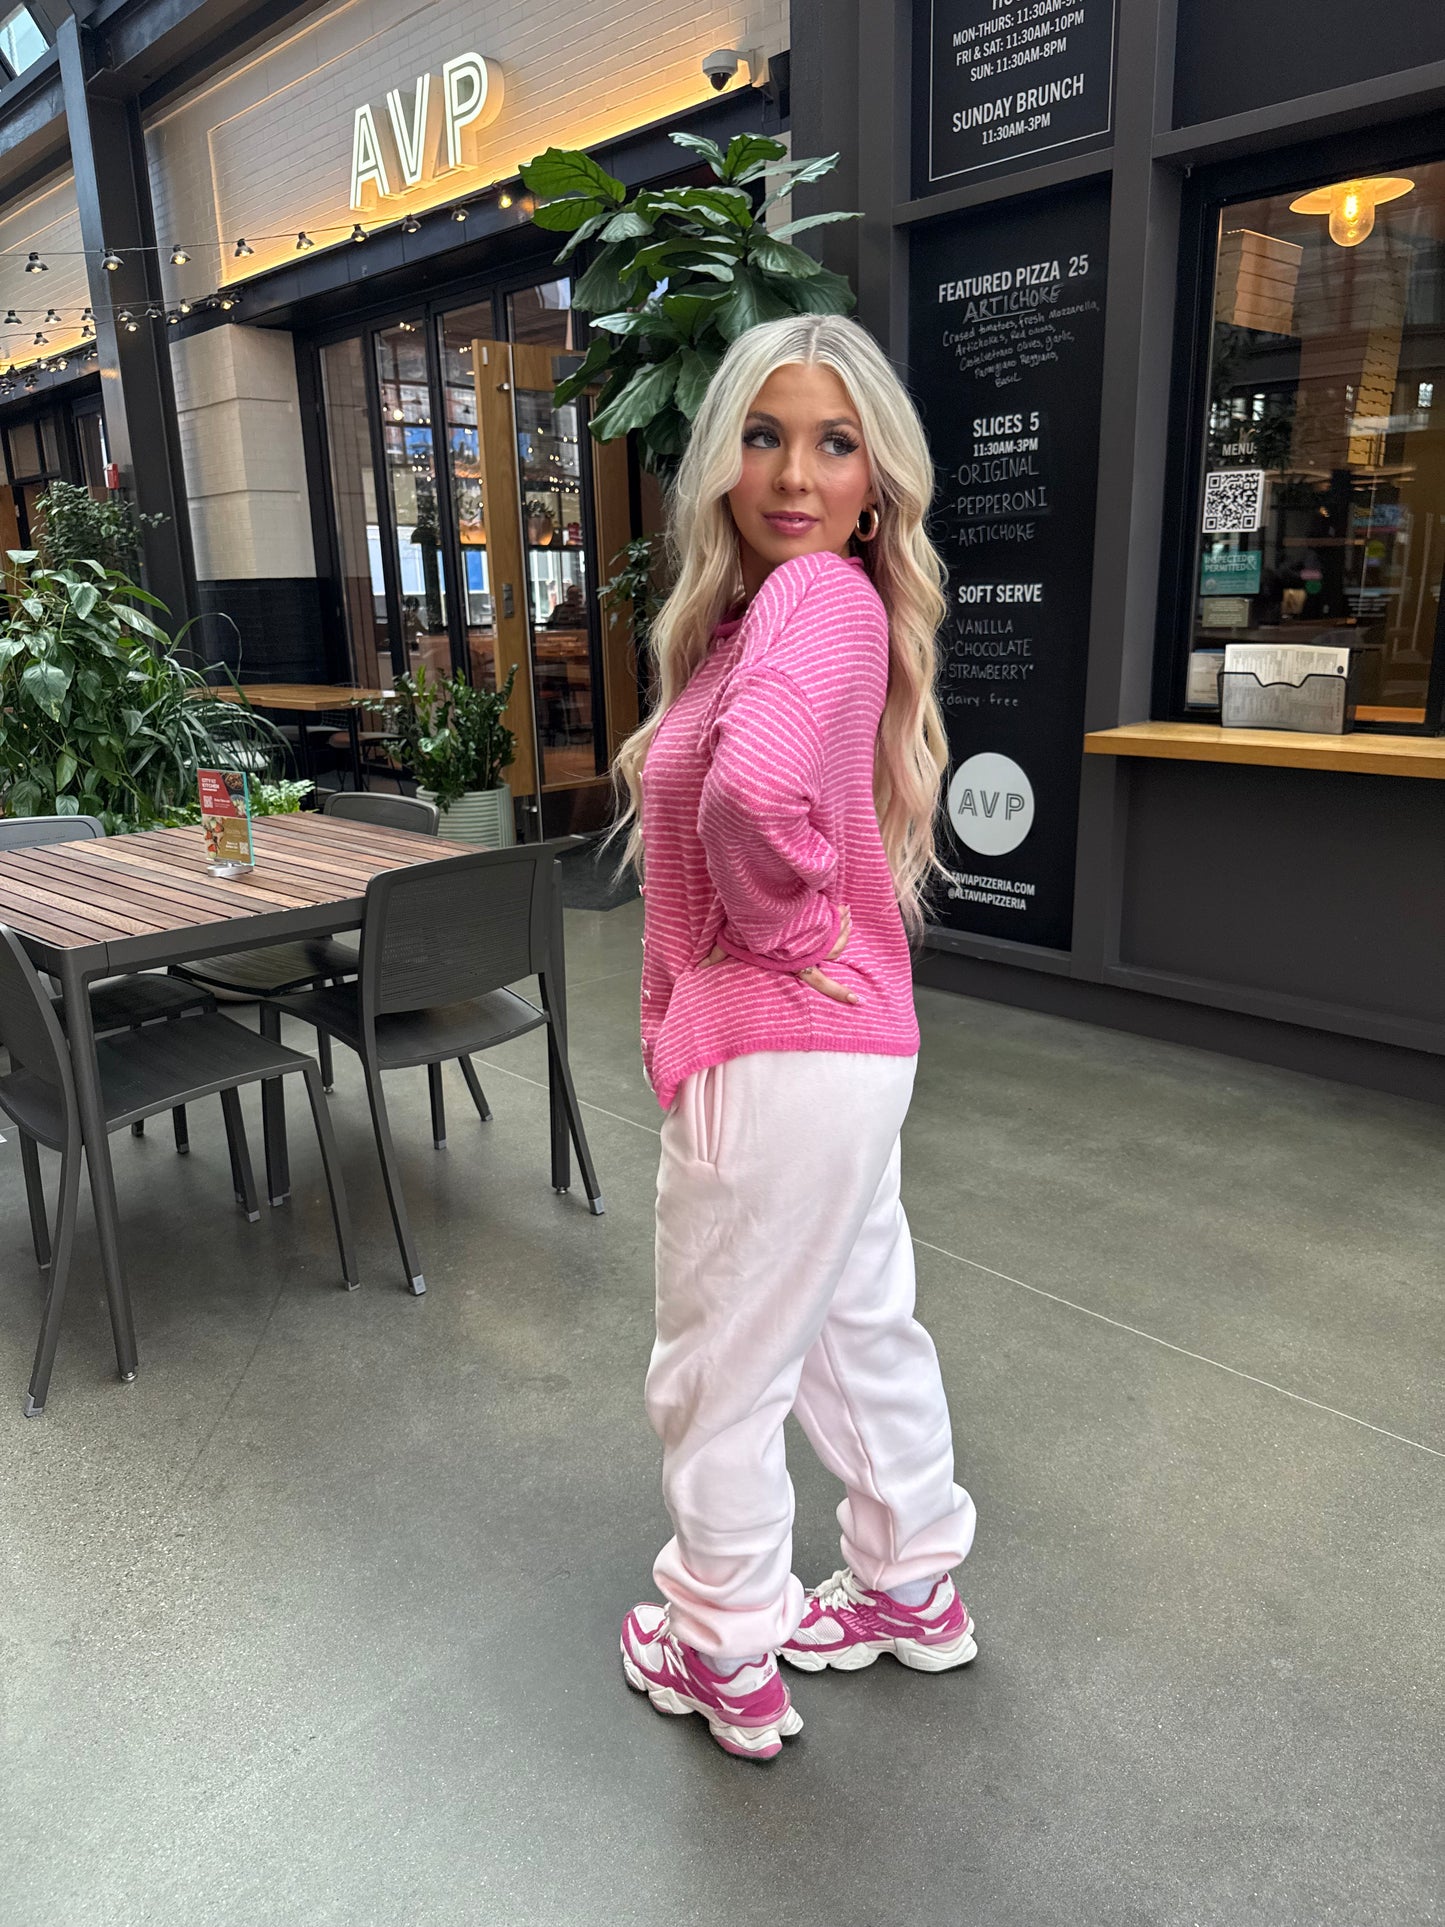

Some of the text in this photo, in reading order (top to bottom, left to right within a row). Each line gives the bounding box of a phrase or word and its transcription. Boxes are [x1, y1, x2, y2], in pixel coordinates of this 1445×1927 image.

[952, 14, 1014, 47] MON-THURS:
[956, 9, 1085, 66] FRI & SAT: 11:30AM-10PM
[970, 37, 1067, 82] SUN: 11:30AM-8PM
[952, 73, 1085, 133] SUNDAY BRUNCH
[350, 52, 490, 210] AVP
[982, 112, 1051, 145] 11:30AM-3PM
[938, 254, 1089, 303] FEATURED PIZZA 25
[962, 282, 1064, 324] ARTICHOKE
[972, 411, 1040, 438] SLICES 5
[973, 437, 1039, 457] 11:30AM-3PM
[958, 583, 1043, 603] SOFT SERVE
[990, 692, 1019, 707] free
[957, 788, 1026, 821] AVP
[948, 887, 1027, 911] @ALTAVIAPIZZERIA
